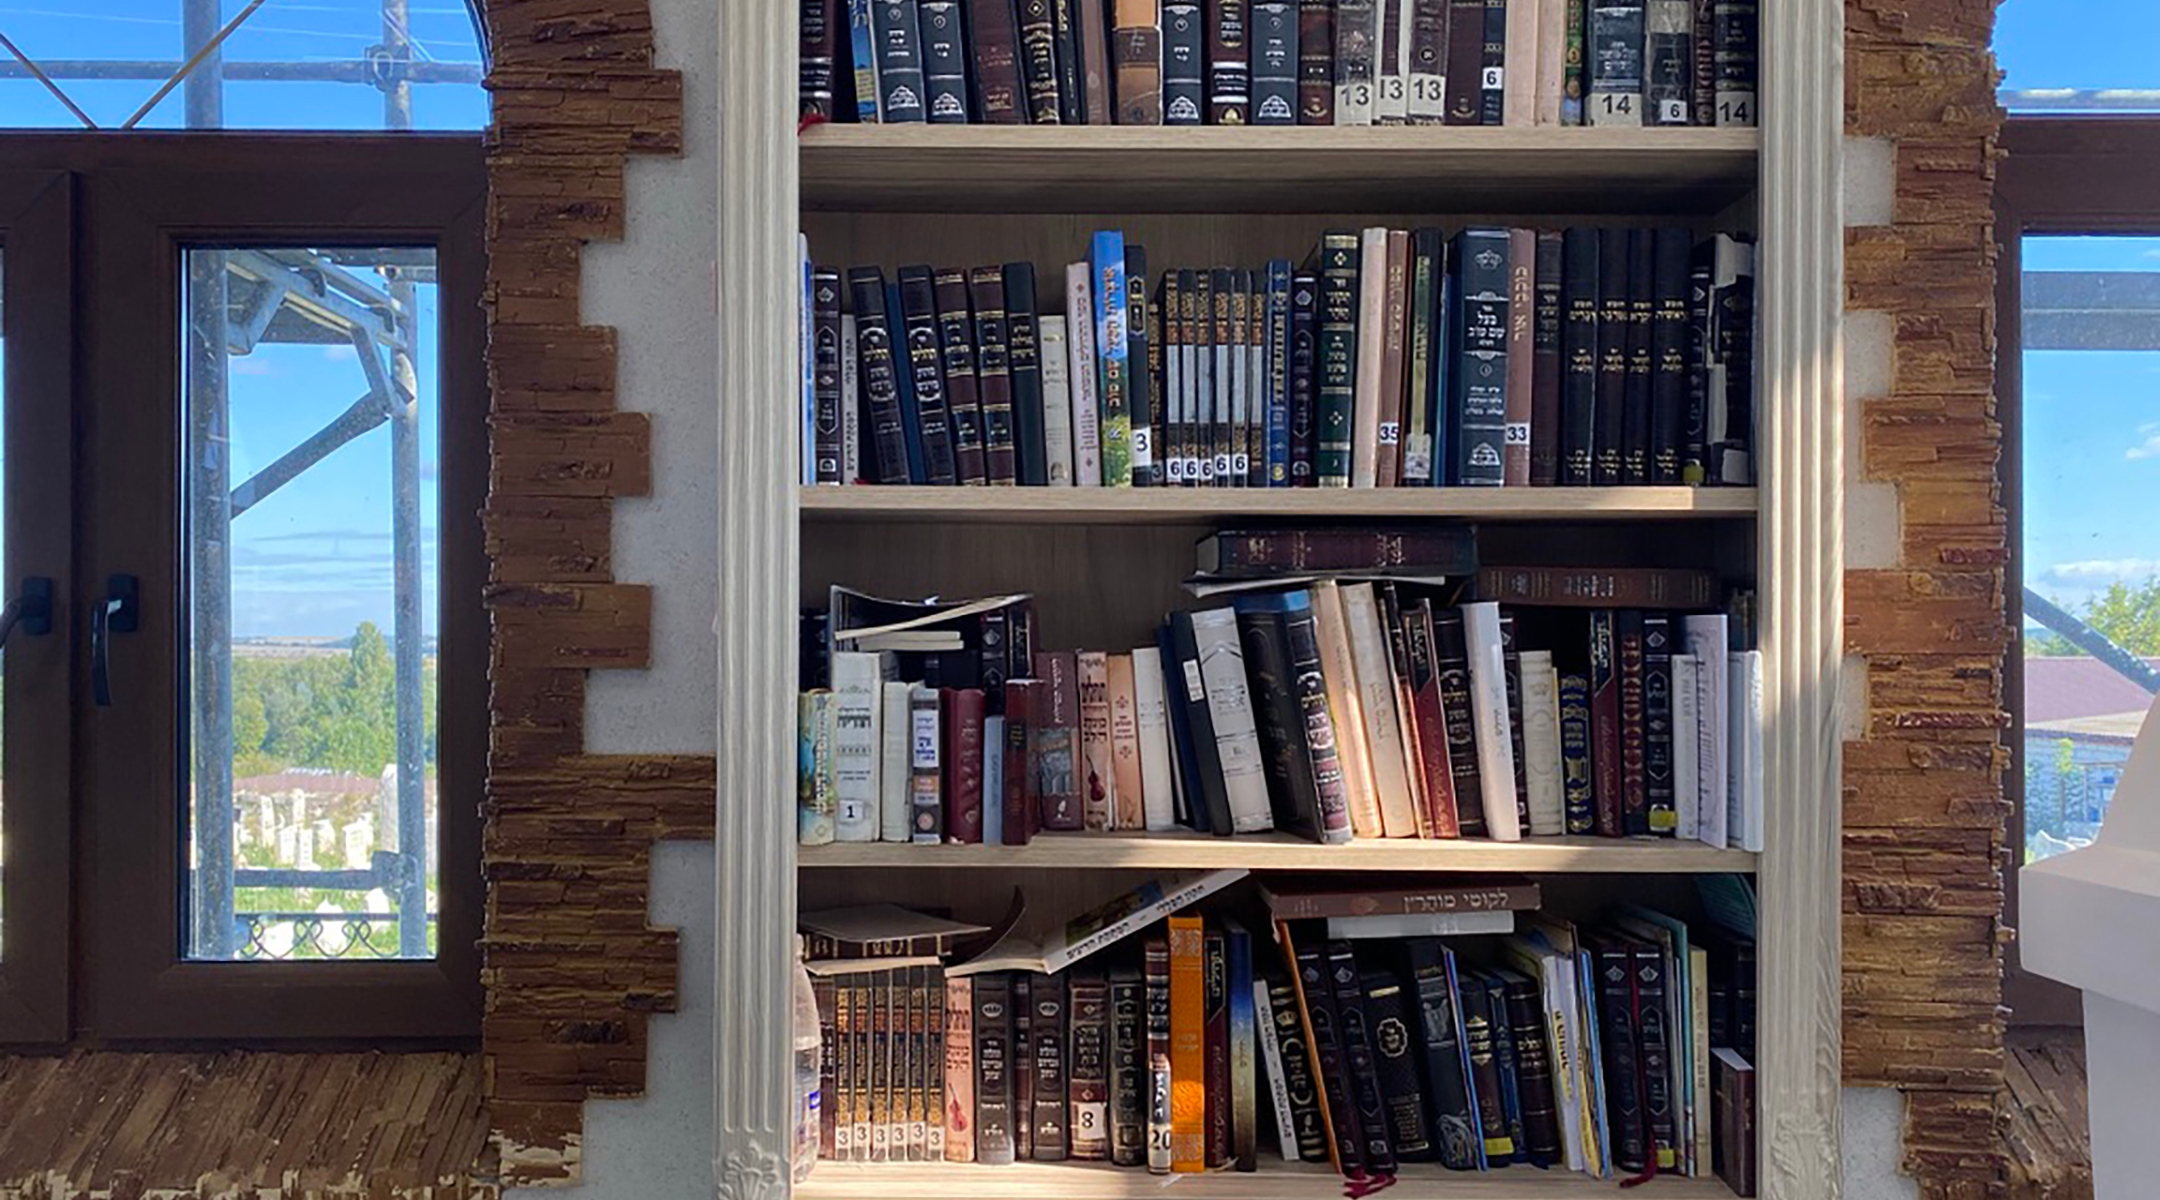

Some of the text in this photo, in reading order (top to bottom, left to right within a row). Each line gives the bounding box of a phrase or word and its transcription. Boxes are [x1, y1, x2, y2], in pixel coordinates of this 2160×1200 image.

[1486, 71, 1497, 85] 6
[1341, 86, 1369, 105] 13
[1380, 79, 1403, 99] 13
[1413, 79, 1441, 100] 13
[1602, 95, 1631, 114] 14
[1670, 104, 1680, 118] 6
[1719, 101, 1749, 122] 14
[1513, 266, 1530, 342] כוכבי אור
[1109, 383, 1121, 407] טוב
[1380, 427, 1399, 440] 35
[1507, 427, 1527, 440] 33
[1136, 433, 1149, 451] 3
[1170, 461, 1181, 475] 6
[1186, 461, 1197, 475] 6
[1202, 462, 1213, 476] 6
[1216, 457, 1227, 471] 6
[1235, 456, 1246, 470] 6
[846, 806, 855, 819] 1
[1463, 887, 1509, 910] לקוטי
[1082, 1112, 1094, 1128] 8
[838, 1131, 849, 1145] 3
[857, 1126, 868, 1140] 3
[875, 1129, 886, 1143] 3
[894, 1128, 904, 1142] 3
[914, 1124, 924, 1138] 3
[930, 1131, 941, 1145] 3
[1152, 1130, 1171, 1150] 20
